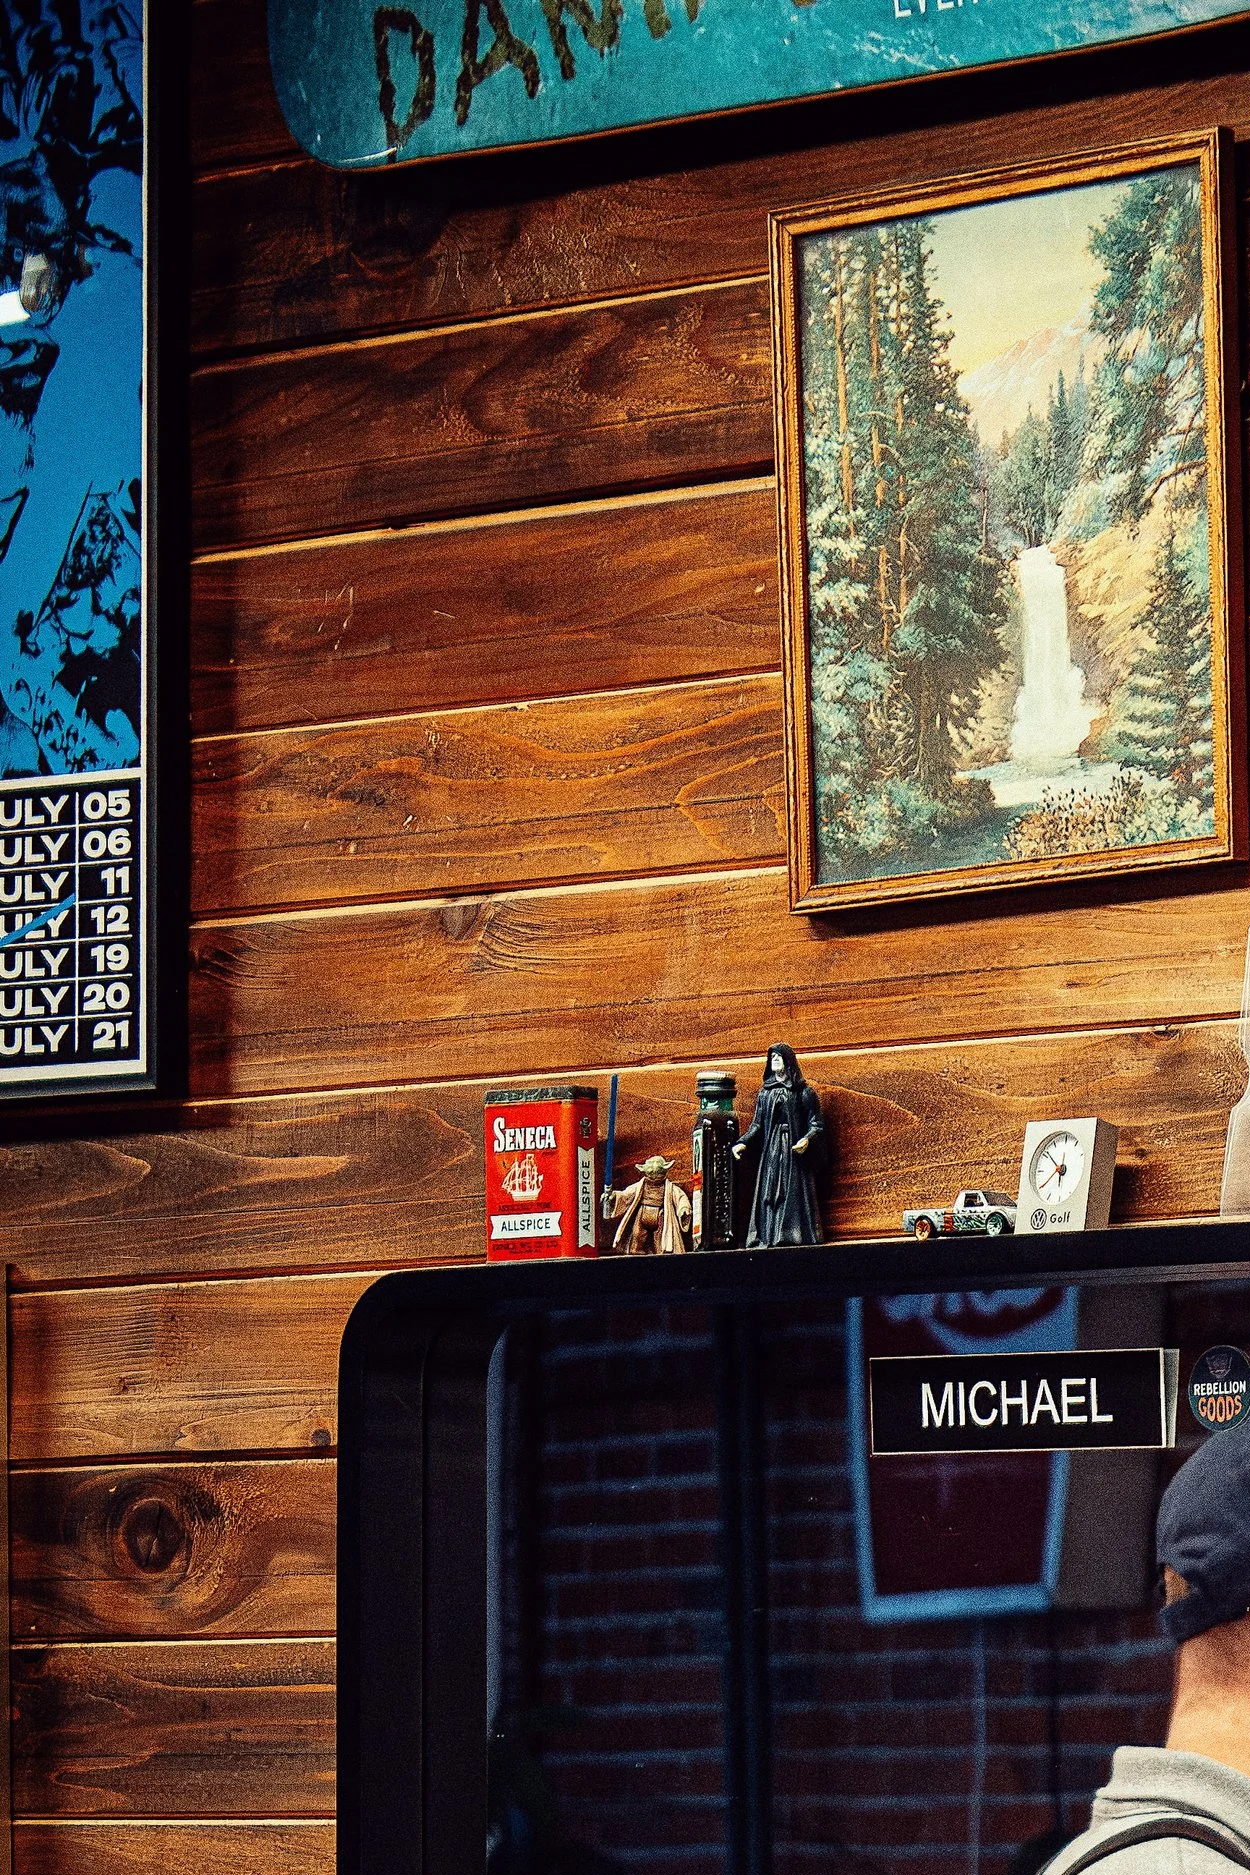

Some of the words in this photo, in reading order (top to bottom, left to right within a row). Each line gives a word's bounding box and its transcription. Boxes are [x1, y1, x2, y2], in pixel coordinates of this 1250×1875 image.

[83, 789, 131, 820] 05
[83, 828, 131, 859] 06
[101, 866, 130, 897] 11
[91, 905, 130, 935] 12
[91, 943, 130, 973] 19
[83, 982, 130, 1013] 20
[93, 1019, 130, 1050] 21
[493, 1116, 557, 1153] SENECA
[582, 1160, 590, 1232] ALLSPICE
[501, 1218, 551, 1232] ALLSPICE
[1050, 1211, 1071, 1224] Golf
[921, 1377, 1113, 1428] MICHAEL
[1193, 1380, 1247, 1396] REBELLION
[1198, 1395, 1243, 1422] GOODS
